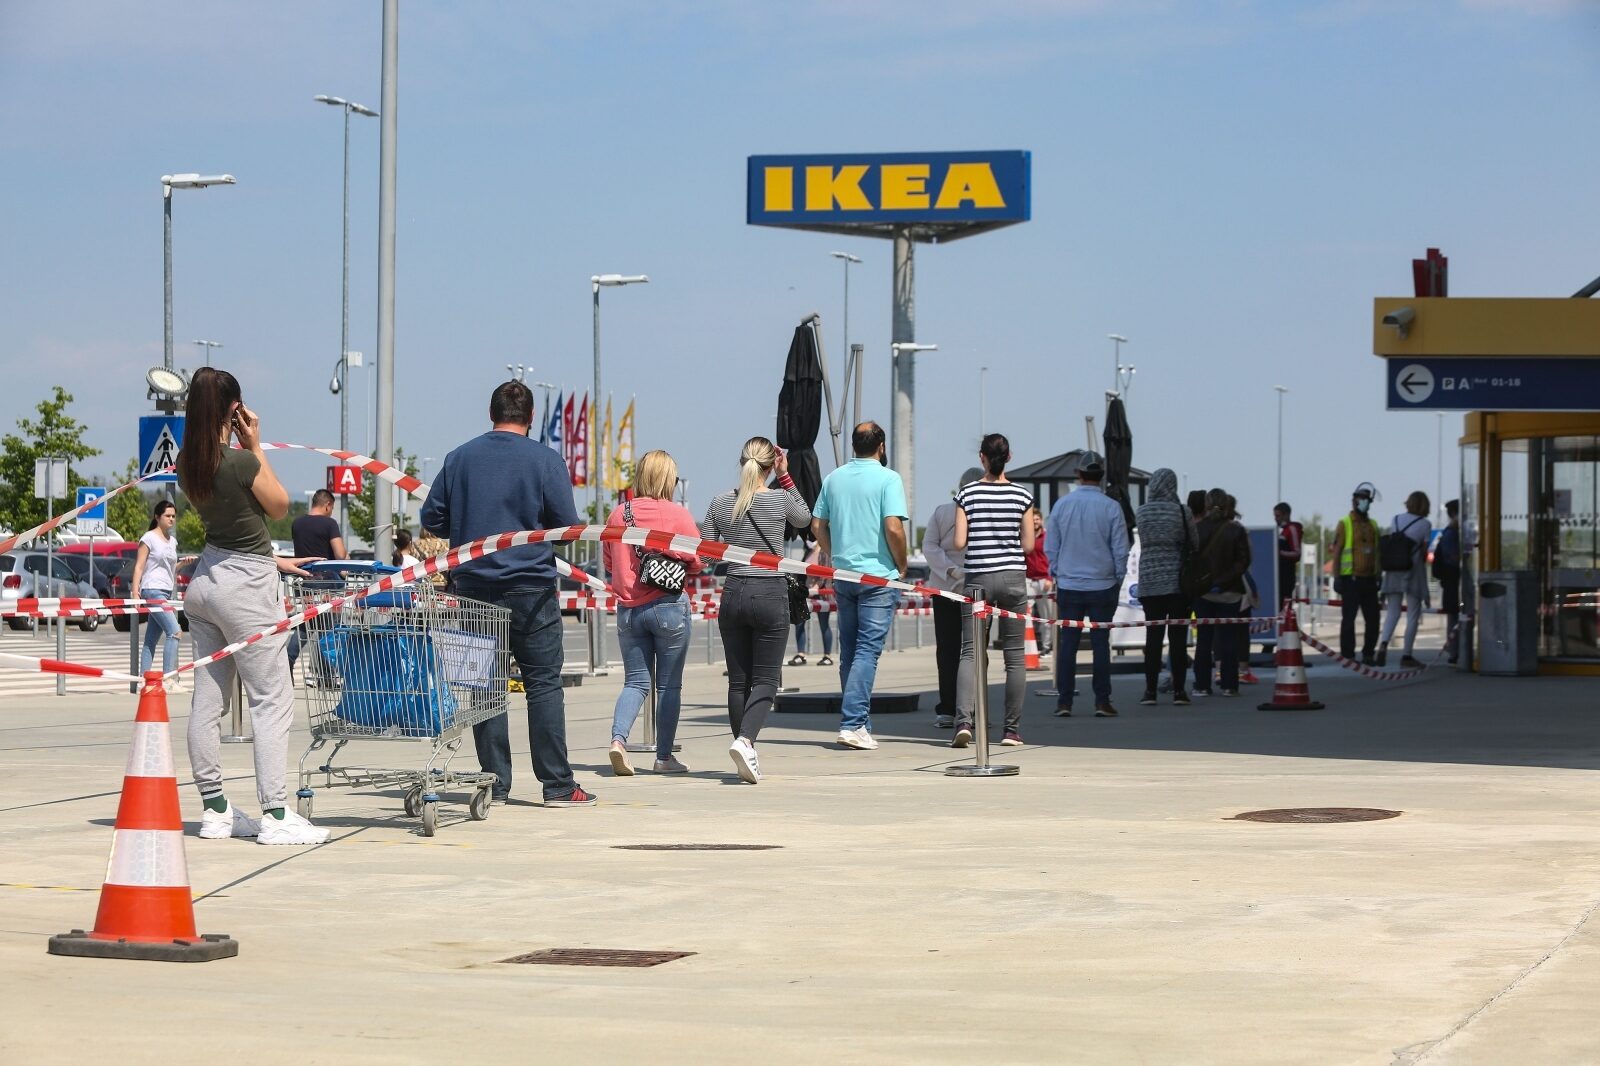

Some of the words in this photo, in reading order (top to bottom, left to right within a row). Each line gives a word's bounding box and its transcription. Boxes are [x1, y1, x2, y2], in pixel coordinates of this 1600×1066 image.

[764, 163, 1006, 211] IKEA
[1459, 378, 1470, 390] A
[340, 468, 356, 485] A
